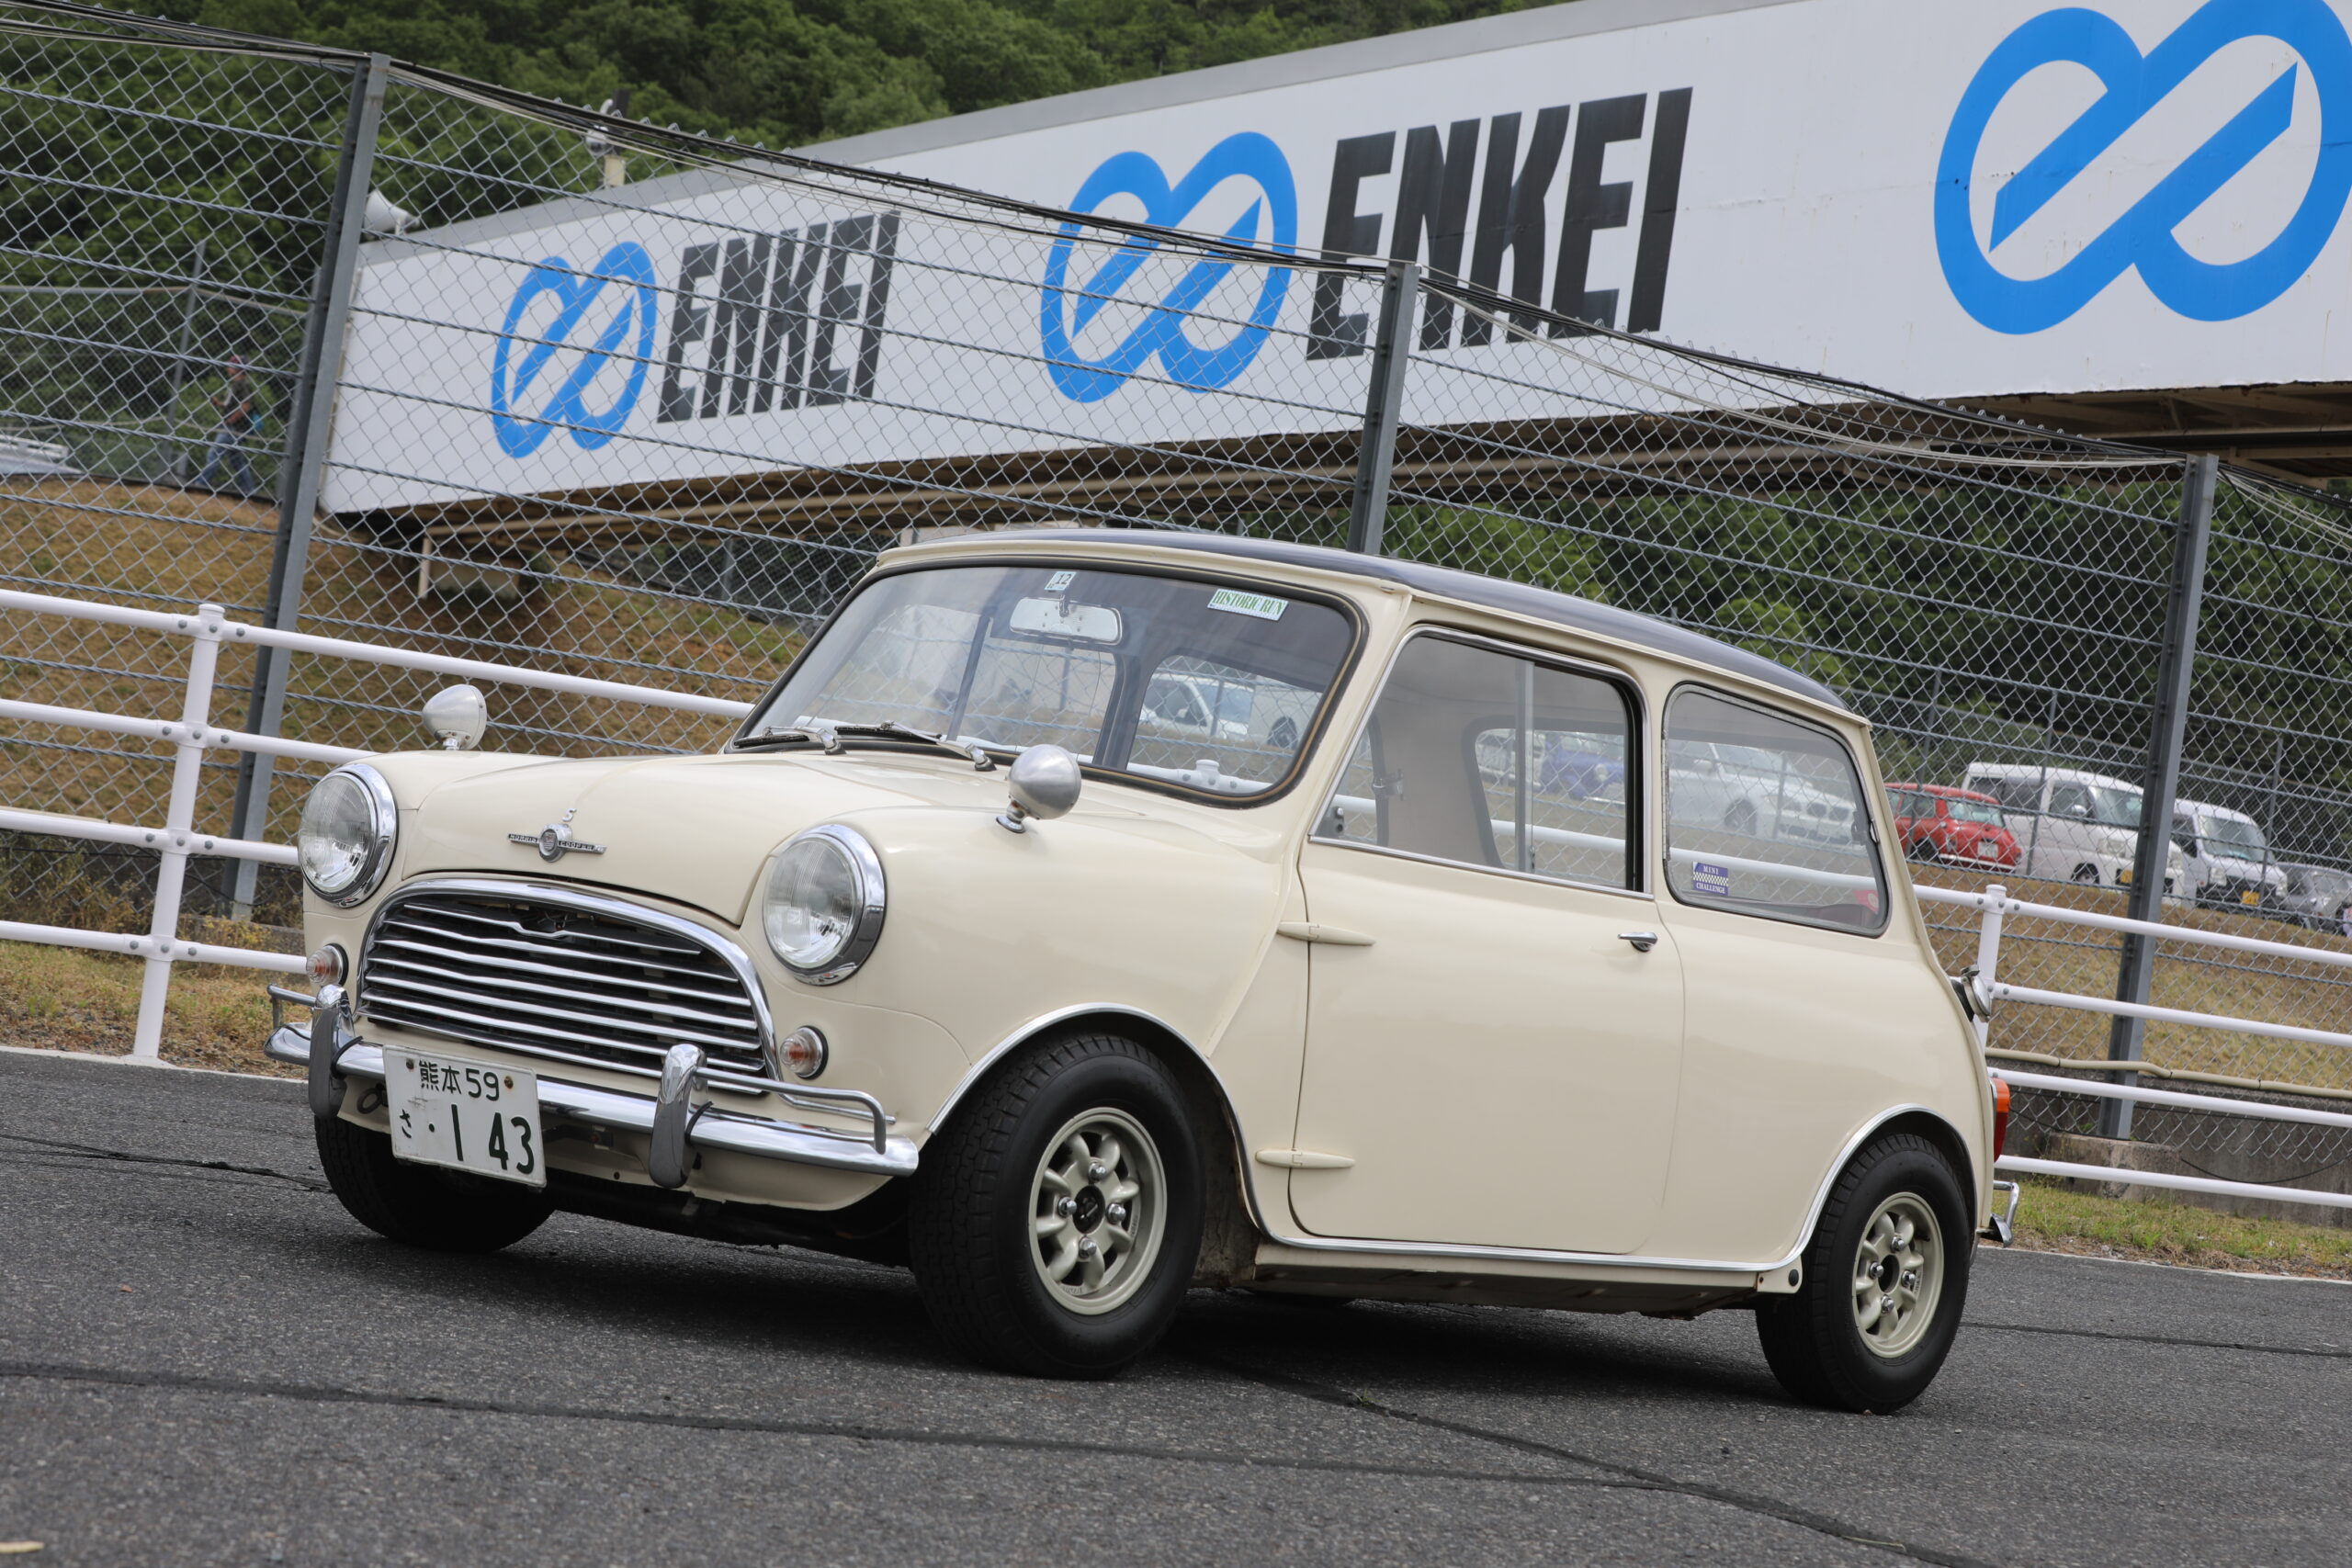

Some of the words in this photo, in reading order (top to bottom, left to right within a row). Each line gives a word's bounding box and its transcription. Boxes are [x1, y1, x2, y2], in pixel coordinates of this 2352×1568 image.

[1306, 86, 1693, 360] ENKEI
[657, 209, 901, 423] ENKEI
[1056, 573, 1072, 585] 12
[1213, 591, 1262, 611] HISTORIC
[1260, 598, 1285, 615] RUN
[1702, 865, 1719, 875] MINI
[1696, 882, 1726, 895] CHALLENGE
